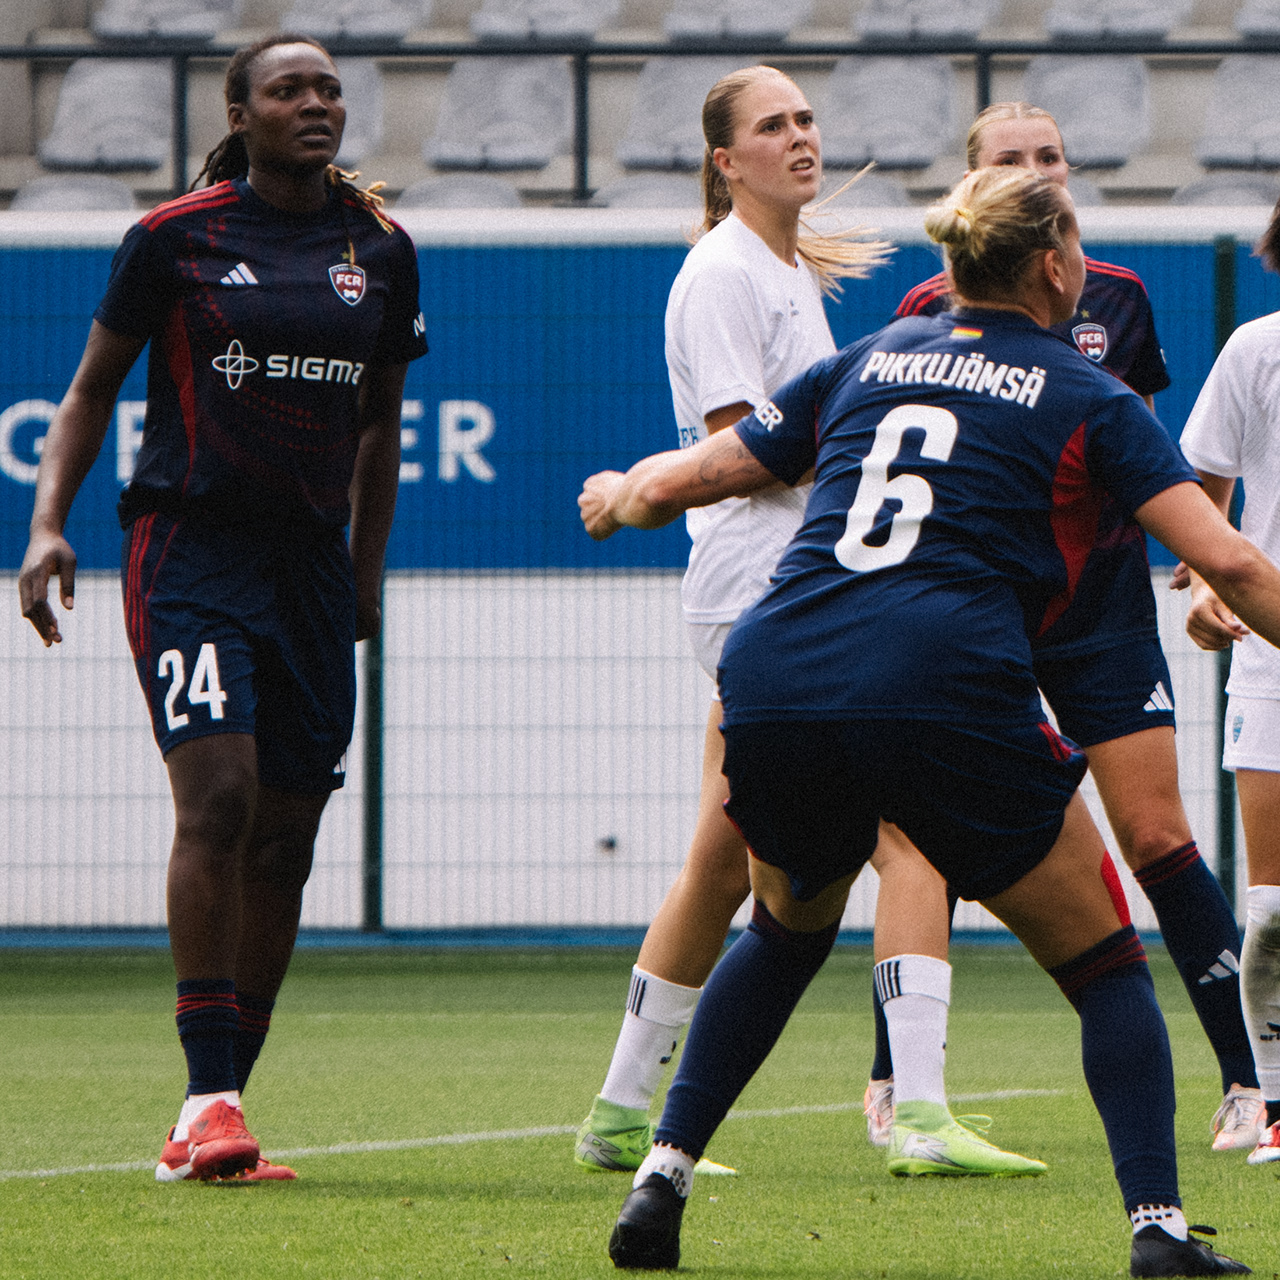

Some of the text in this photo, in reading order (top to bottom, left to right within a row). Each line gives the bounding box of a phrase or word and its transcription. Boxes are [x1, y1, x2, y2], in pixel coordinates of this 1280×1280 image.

[335, 273, 362, 287] FCR
[1079, 332, 1103, 345] FCR
[859, 350, 1047, 410] PIKKUJÄMSÄ
[834, 403, 959, 573] 6
[157, 642, 228, 731] 24
